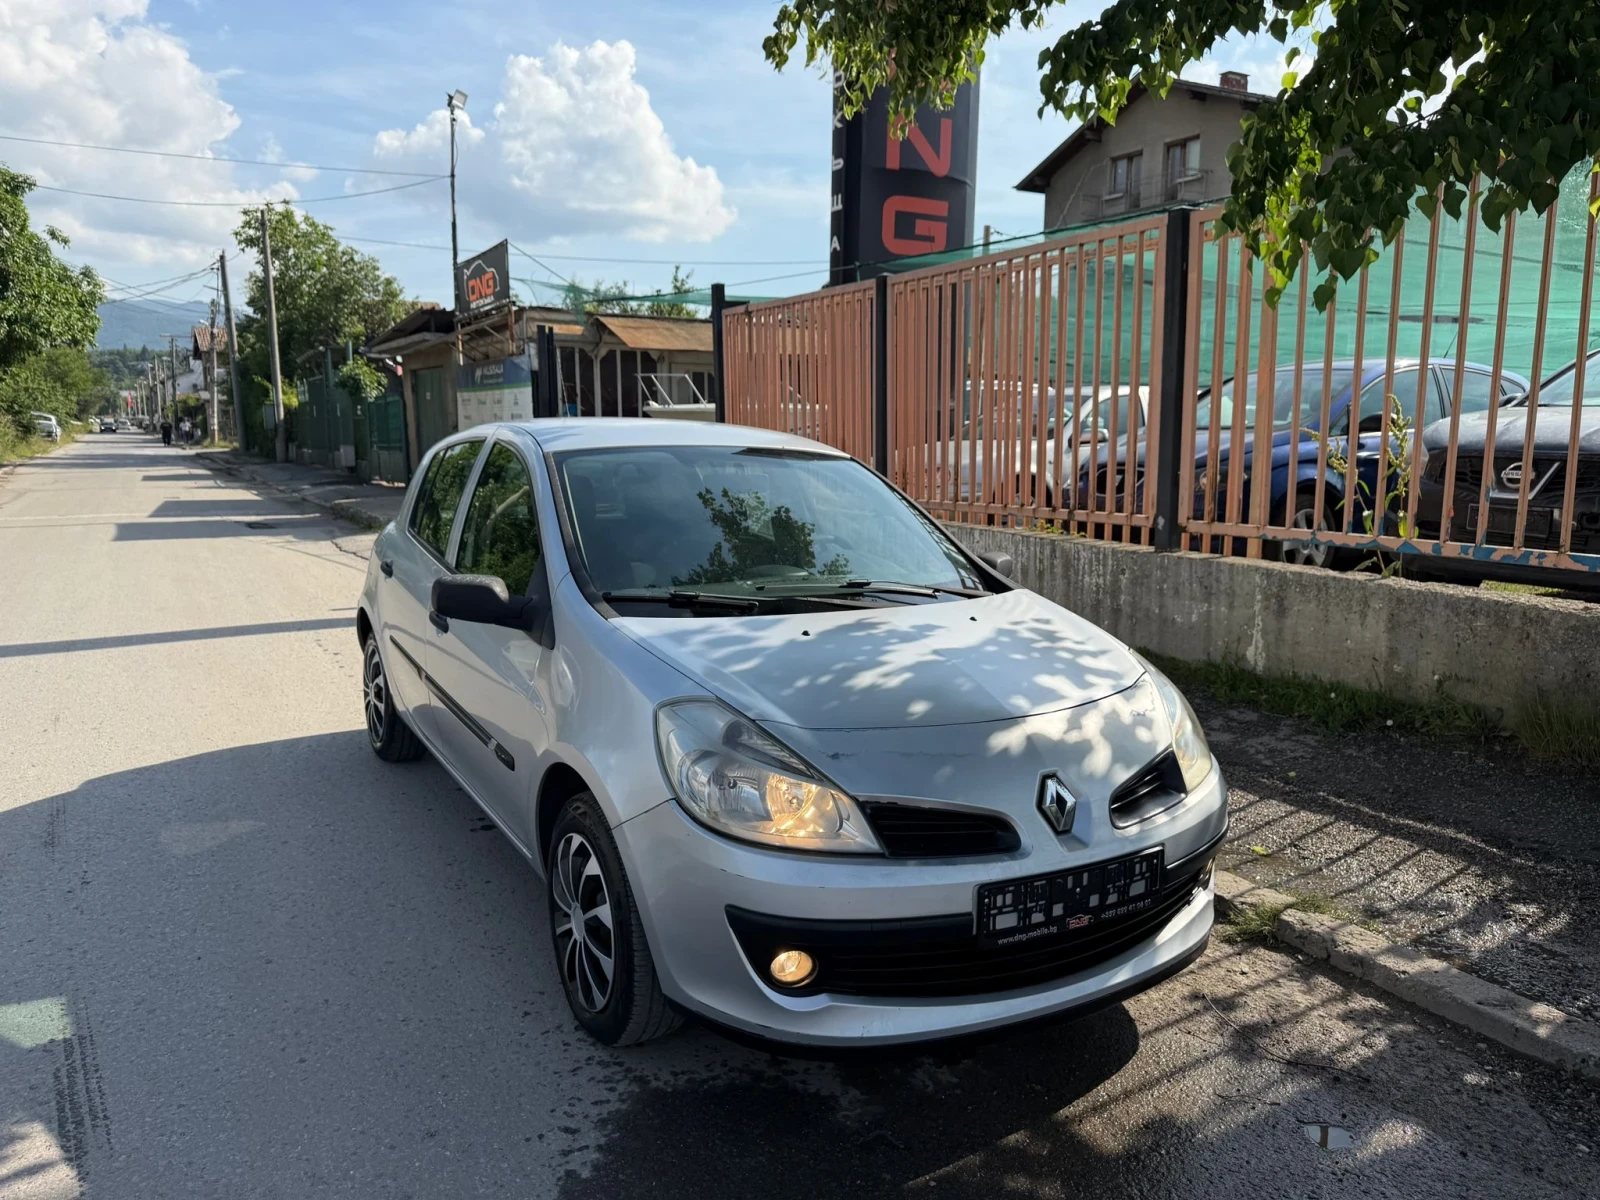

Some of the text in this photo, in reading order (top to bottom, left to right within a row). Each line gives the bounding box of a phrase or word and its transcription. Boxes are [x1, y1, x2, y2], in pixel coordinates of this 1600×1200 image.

[882, 42, 953, 256] NG
[468, 271, 494, 302] DNG
[997, 925, 1058, 945] www.dng.mobile.bg
